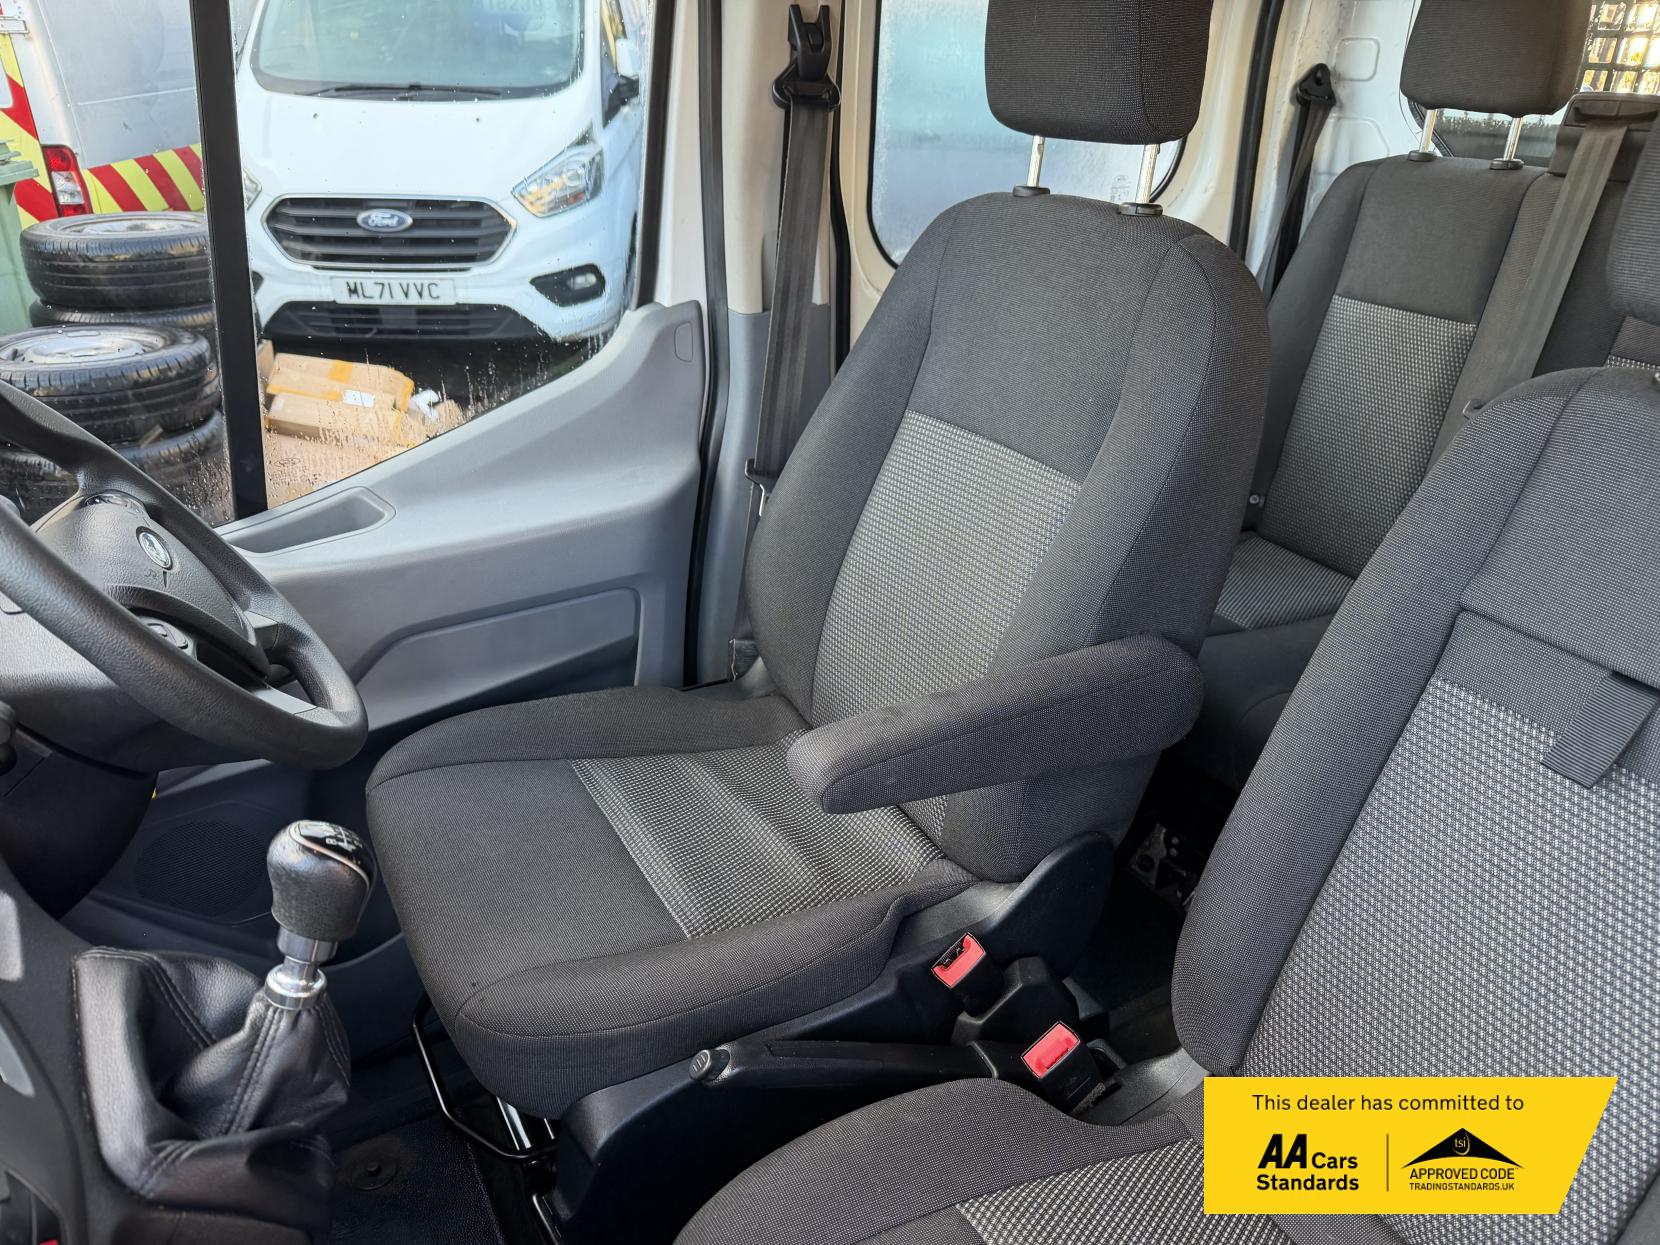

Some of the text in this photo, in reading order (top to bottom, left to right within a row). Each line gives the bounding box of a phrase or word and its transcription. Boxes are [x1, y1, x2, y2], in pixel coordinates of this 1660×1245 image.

[367, 212, 399, 227] Ford
[346, 281, 440, 299] ML71 VVC
